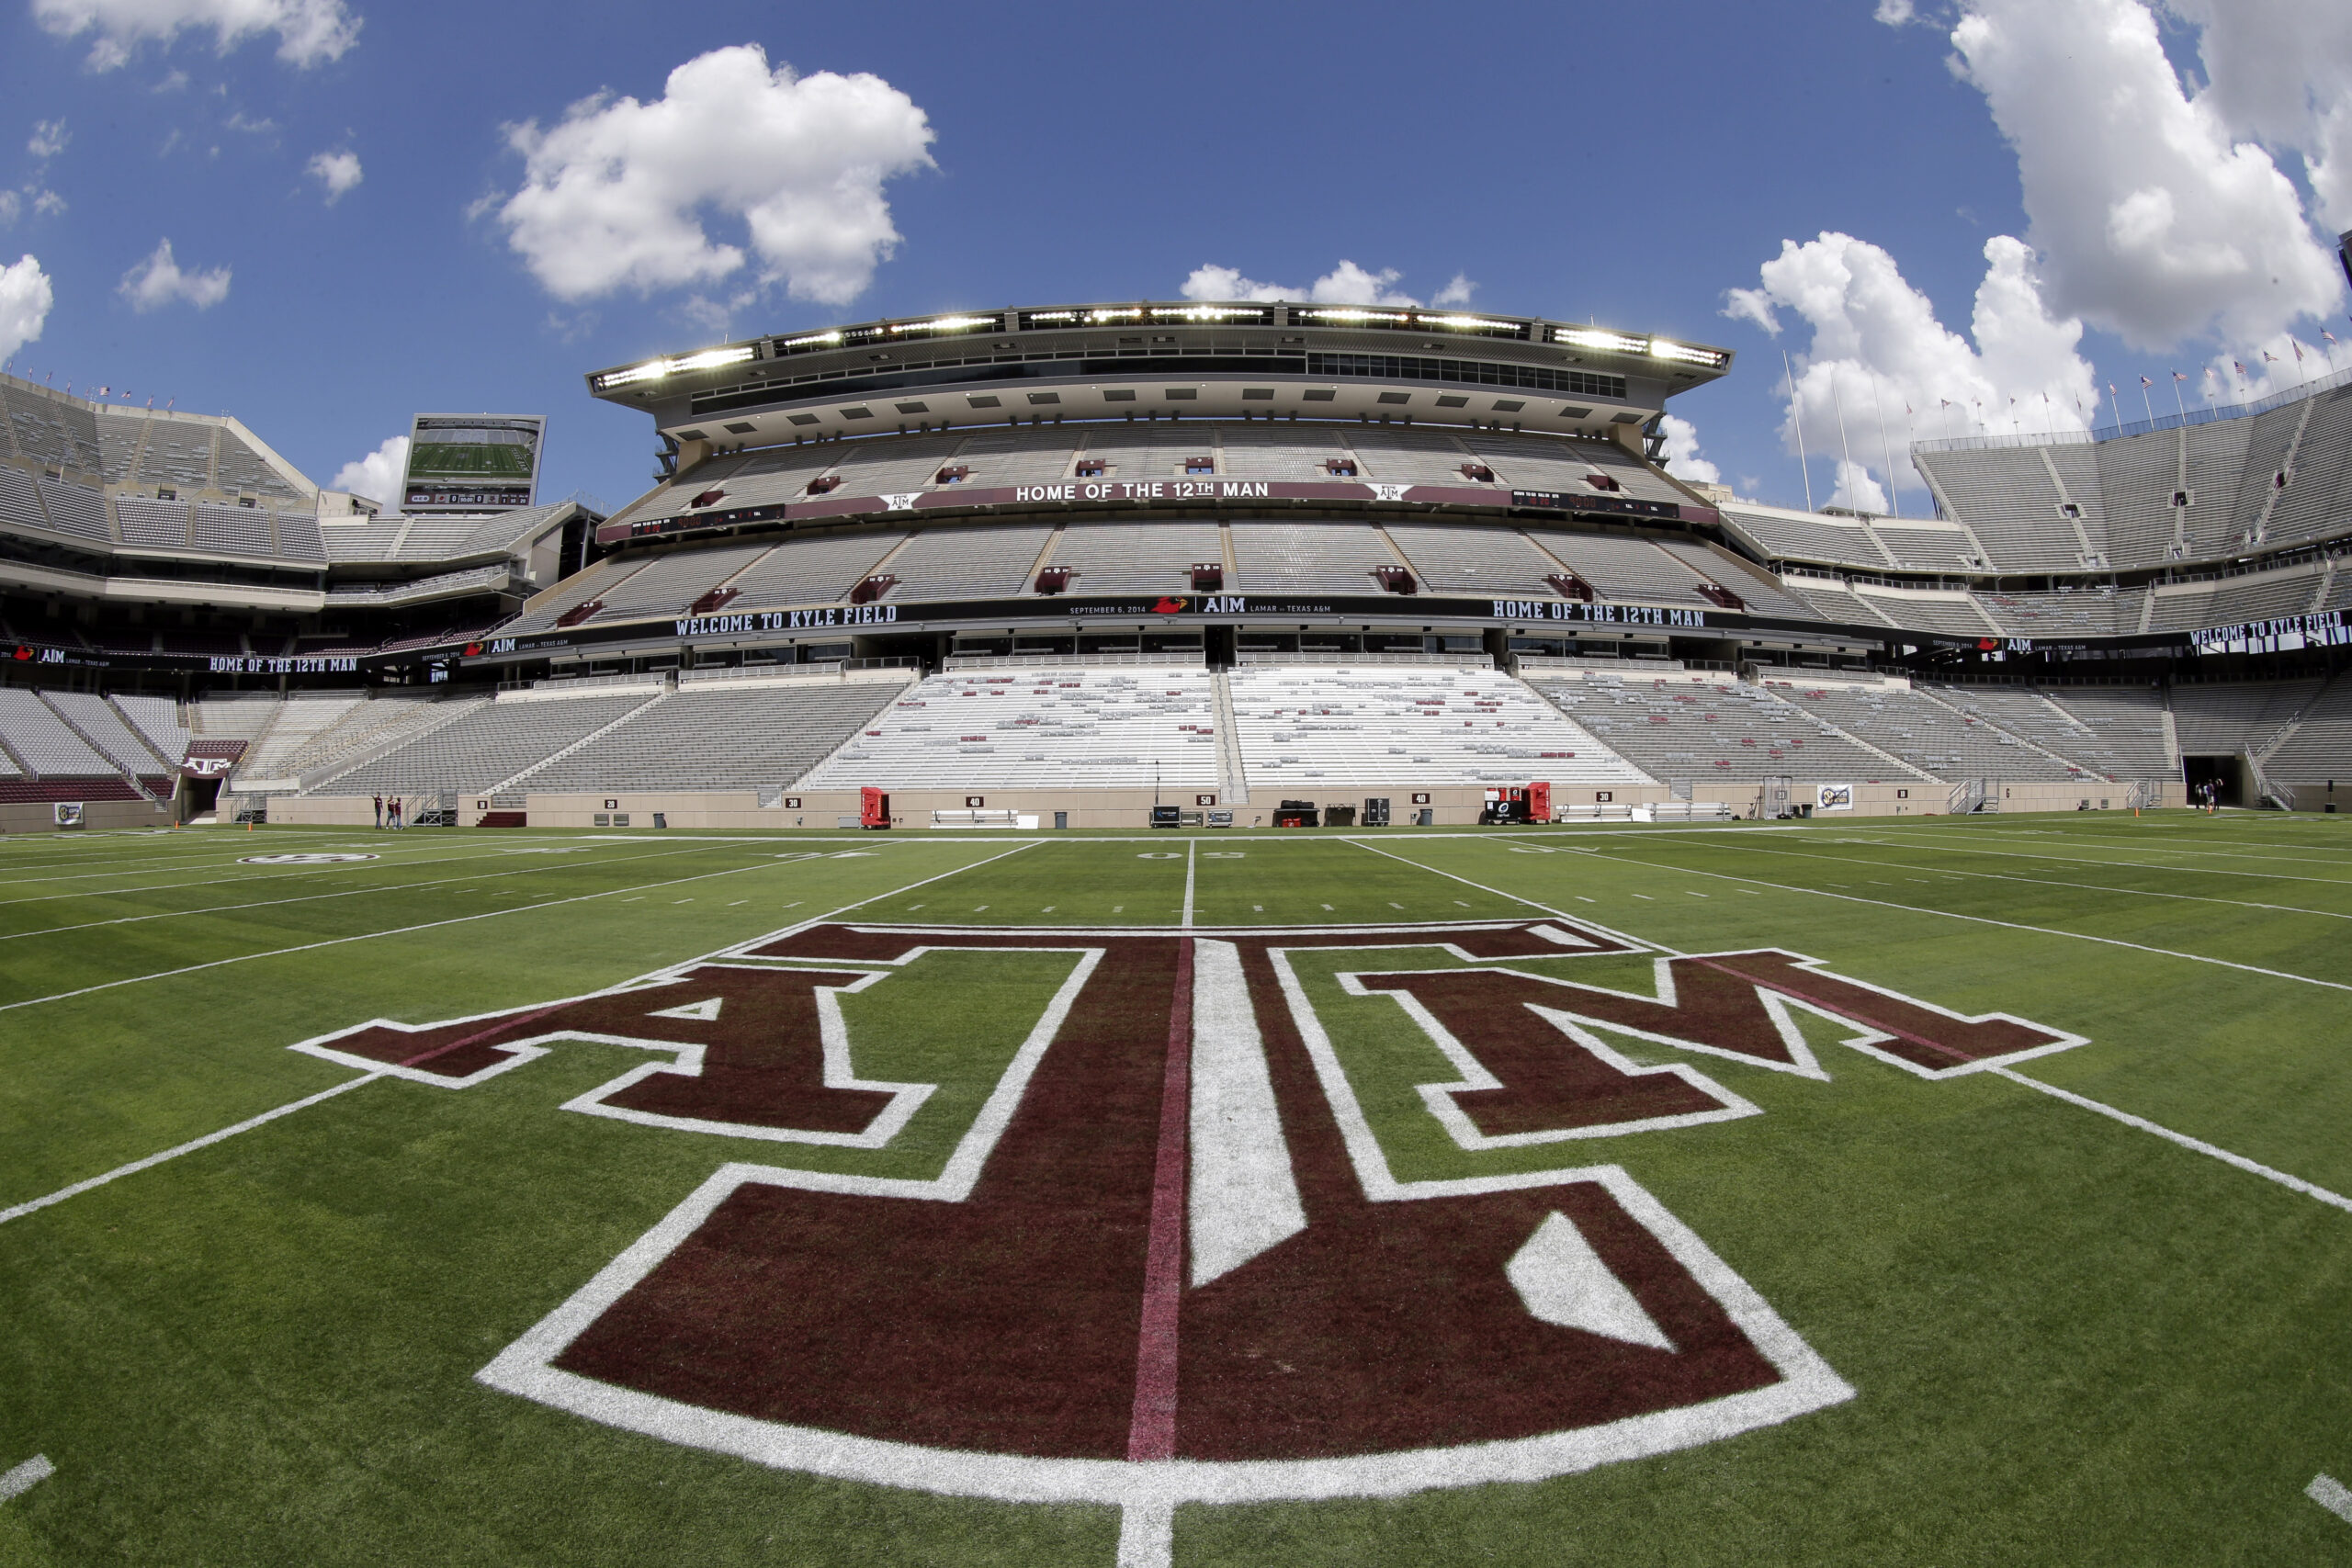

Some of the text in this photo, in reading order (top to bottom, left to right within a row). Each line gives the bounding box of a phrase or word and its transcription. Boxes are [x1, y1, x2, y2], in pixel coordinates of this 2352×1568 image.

[1016, 481, 1269, 502] HOME OF THE 12TH MAN
[1069, 606, 1115, 615] SEPTEMBER
[1493, 600, 1704, 627] HOME OF THE 12TH MAN
[676, 605, 898, 637] WELCOME TO KYLE FIELD
[2190, 611, 2341, 646] WELCOME TO KYLE FIELD
[519, 642, 535, 650] LAMAR
[209, 657, 357, 672] HOME OF THE 12TH MAN
[969, 797, 979, 807] 40
[1200, 795, 1211, 805] 50
[1416, 795, 1426, 804] 40
[1599, 793, 1609, 802] 30
[788, 799, 798, 808] 30
